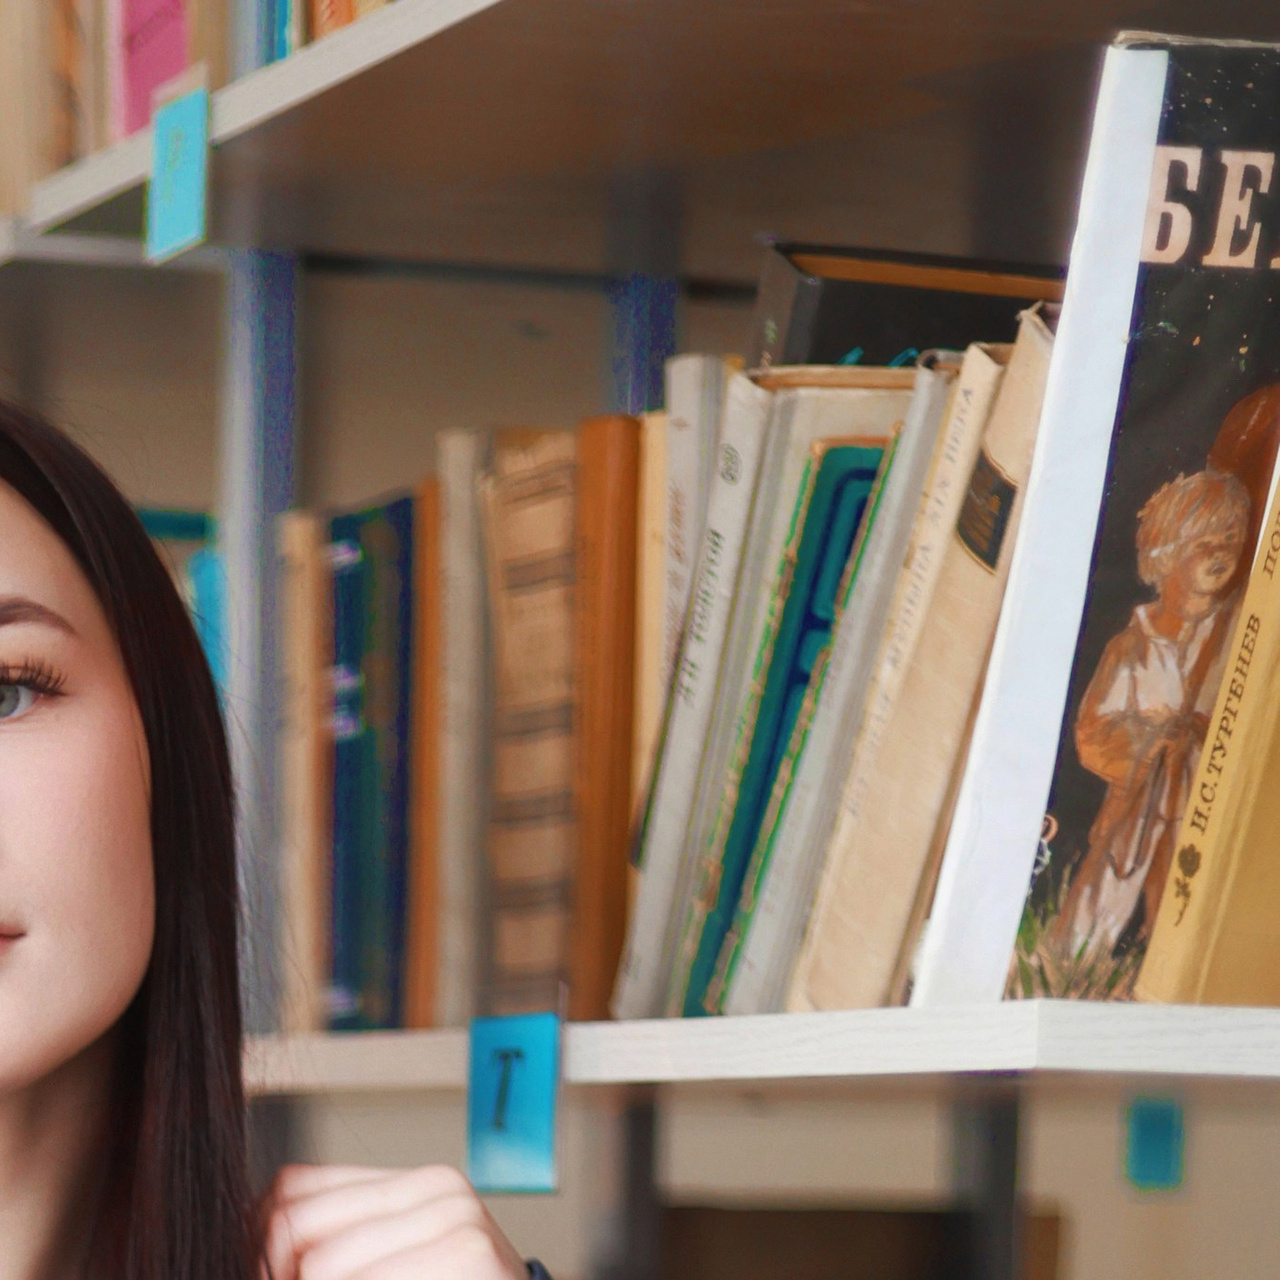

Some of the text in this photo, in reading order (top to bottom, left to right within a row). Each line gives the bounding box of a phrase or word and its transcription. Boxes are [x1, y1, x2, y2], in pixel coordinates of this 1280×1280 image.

[1140, 144, 1280, 269] БЕ
[1262, 510, 1280, 580] ПО
[492, 1047, 524, 1131] Т
